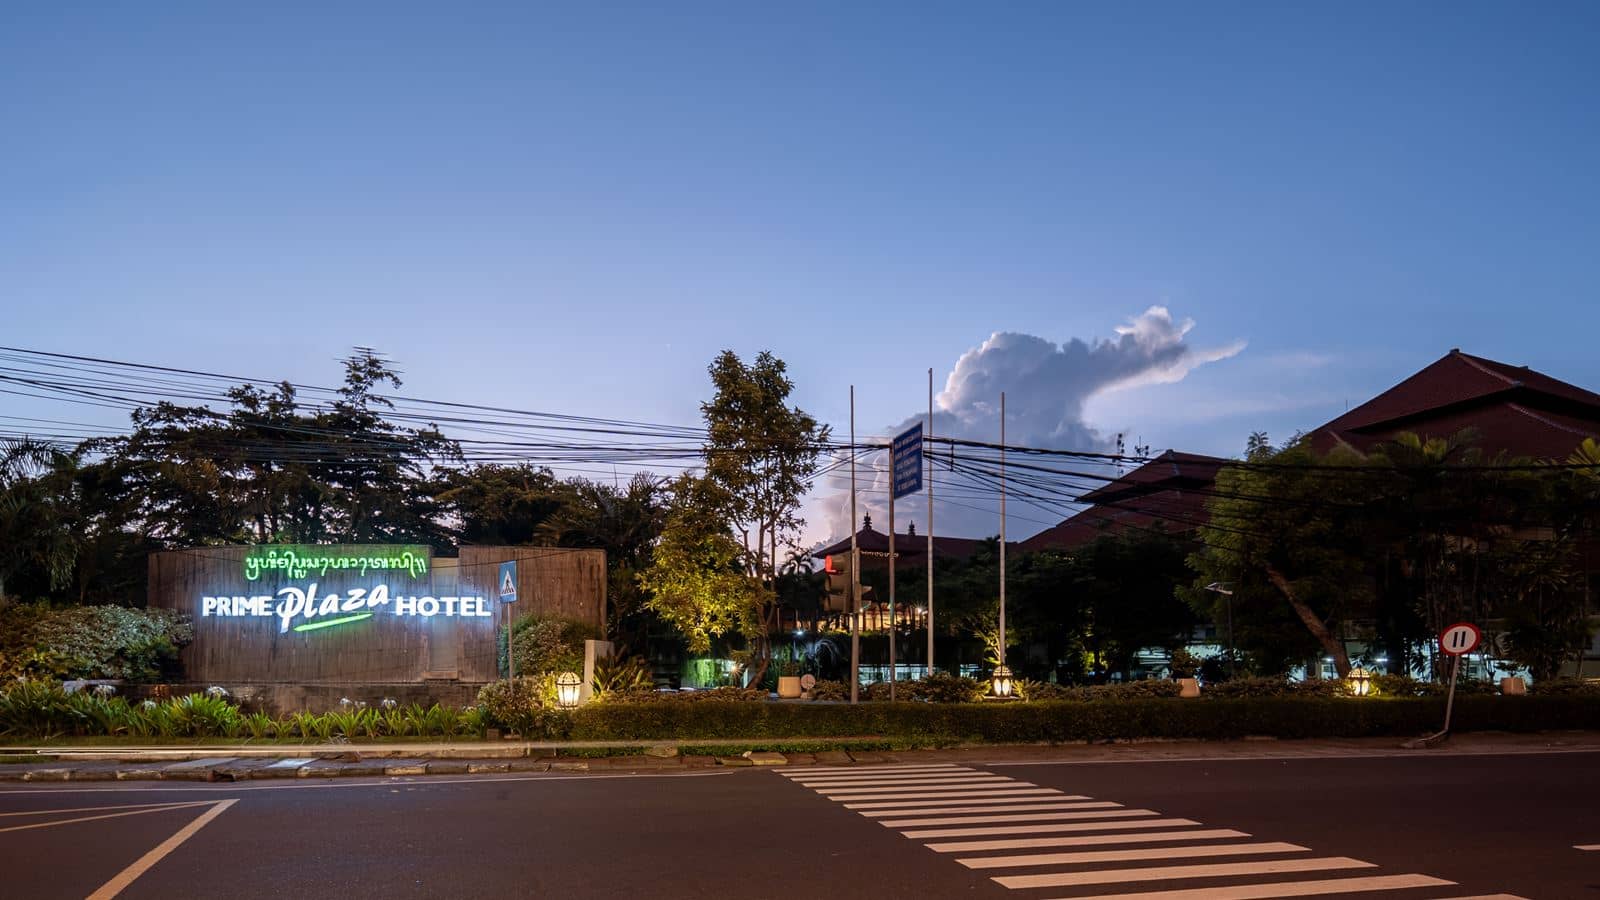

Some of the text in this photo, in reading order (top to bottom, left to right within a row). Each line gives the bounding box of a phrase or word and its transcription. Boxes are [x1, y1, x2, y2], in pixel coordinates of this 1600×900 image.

[202, 583, 492, 633] PRIME Plaza HOTEL
